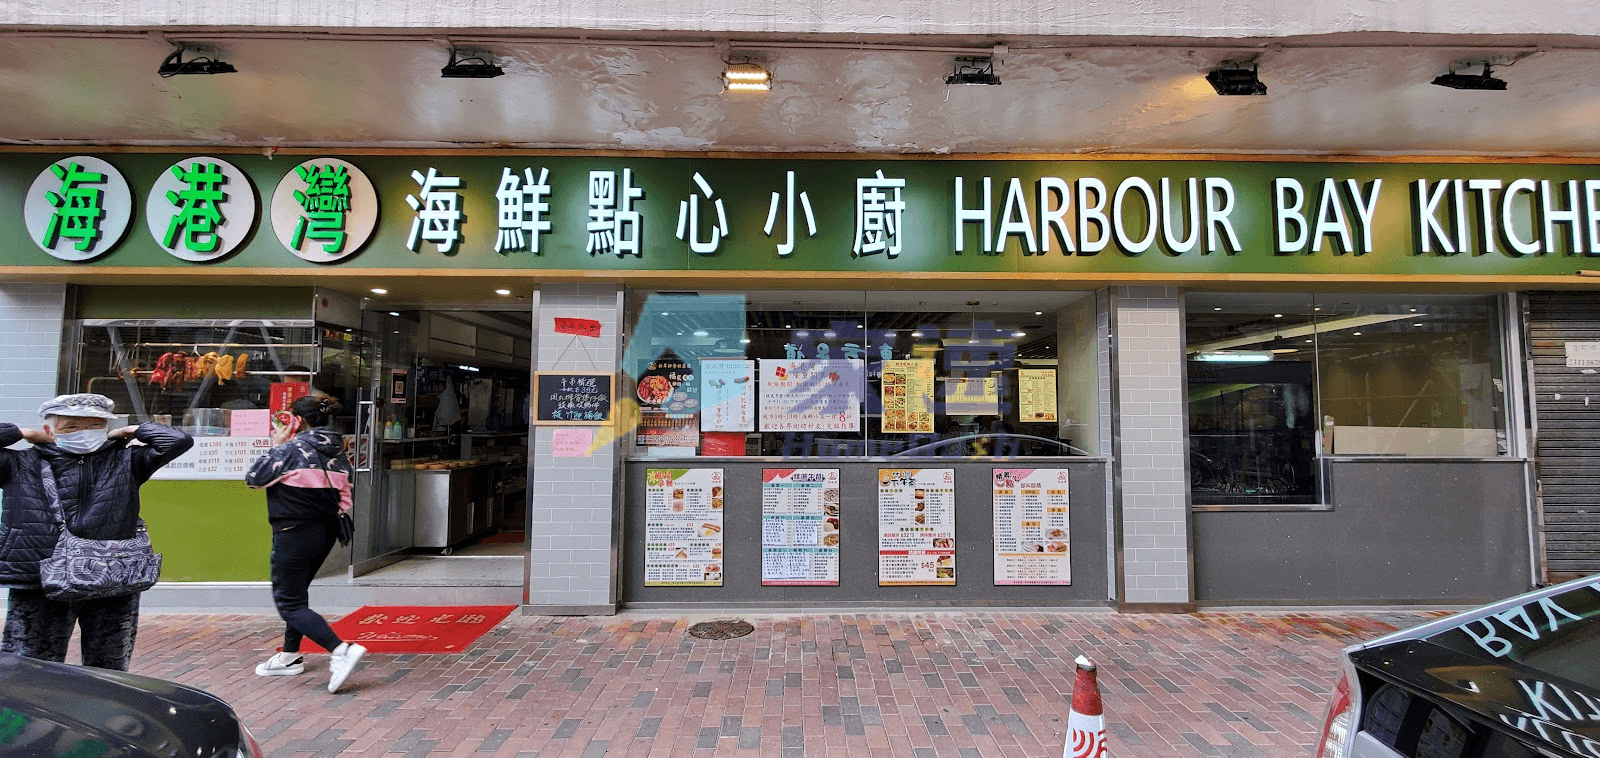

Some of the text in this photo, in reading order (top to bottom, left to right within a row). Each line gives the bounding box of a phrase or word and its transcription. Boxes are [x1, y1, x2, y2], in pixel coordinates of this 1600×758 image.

[42, 161, 906, 257] 海港灣 海鮮點心小廚
[954, 176, 1600, 254] HARBOUR BAY KITCHE
[358, 613, 486, 625] 歡迎光臨
